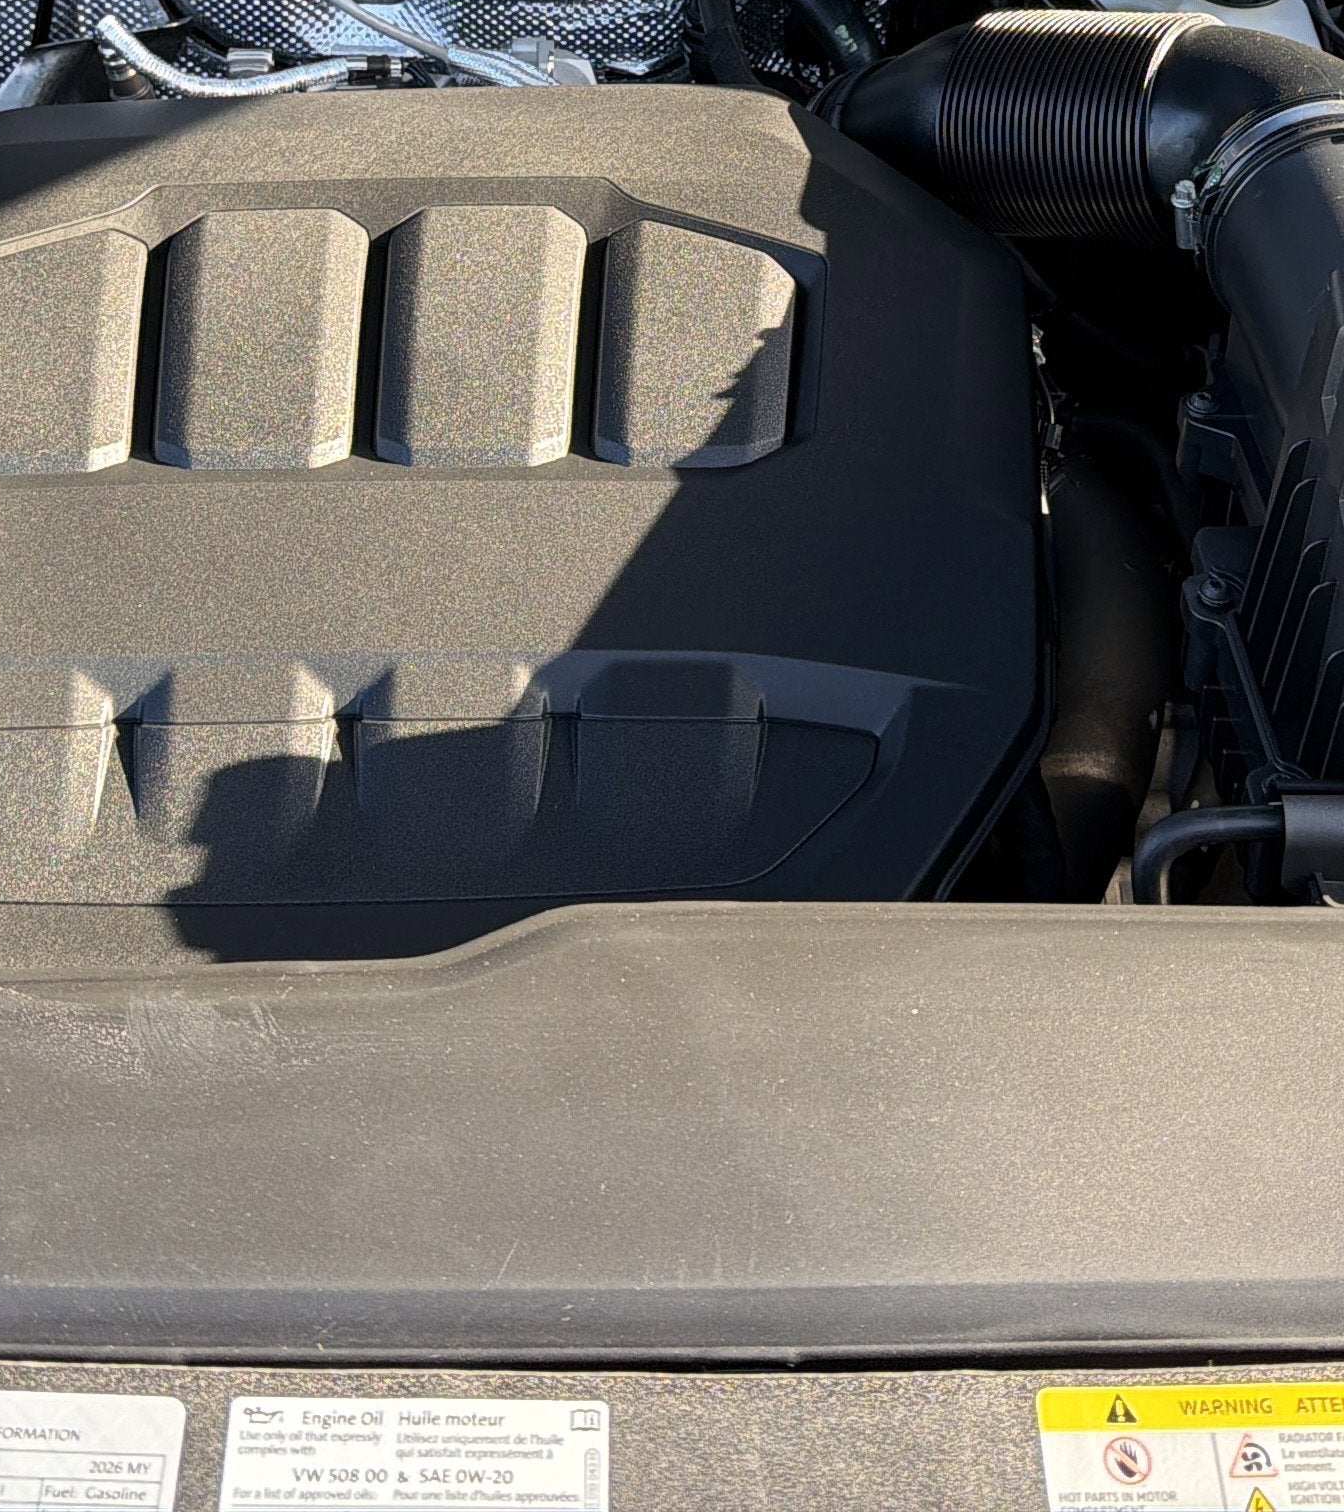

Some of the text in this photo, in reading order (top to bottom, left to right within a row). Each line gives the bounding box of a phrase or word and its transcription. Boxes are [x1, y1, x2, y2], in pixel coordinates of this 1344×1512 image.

[1179, 1397, 1273, 1416] WARNING
[302, 1410, 384, 1429] Engine Oil
[398, 1410, 505, 1427] Huile moteur
[239, 1430, 382, 1445] Use only oil that expressly
[441, 1433, 511, 1447] uniquement
[513, 1433, 528, 1445] de
[1279, 1432, 1334, 1443] RADIATOR
[237, 1445, 316, 1457] complies with
[396, 1447, 415, 1461] qui
[417, 1447, 461, 1458] satisfait
[464, 1448, 544, 1461] expressément
[1281, 1448, 1295, 1459] Le
[89, 1460, 152, 1475] 2026 MY
[292, 1467, 514, 1484] VW 508 00 & SAE 0W-20
[85, 1486, 147, 1501] Gasoline
[1288, 1481, 1316, 1492] HIGH
[233, 1487, 252, 1499] For
[264, 1488, 281, 1499] list
[283, 1487, 296, 1499] of
[299, 1488, 351, 1501] approved
[393, 1489, 419, 1500] Pour
[421, 1491, 443, 1500] une
[445, 1490, 467, 1500] liste
[1059, 1490, 1178, 1502] HOT PARTS IN MOTOR
[1290, 1494, 1341, 1505] IGNITION
